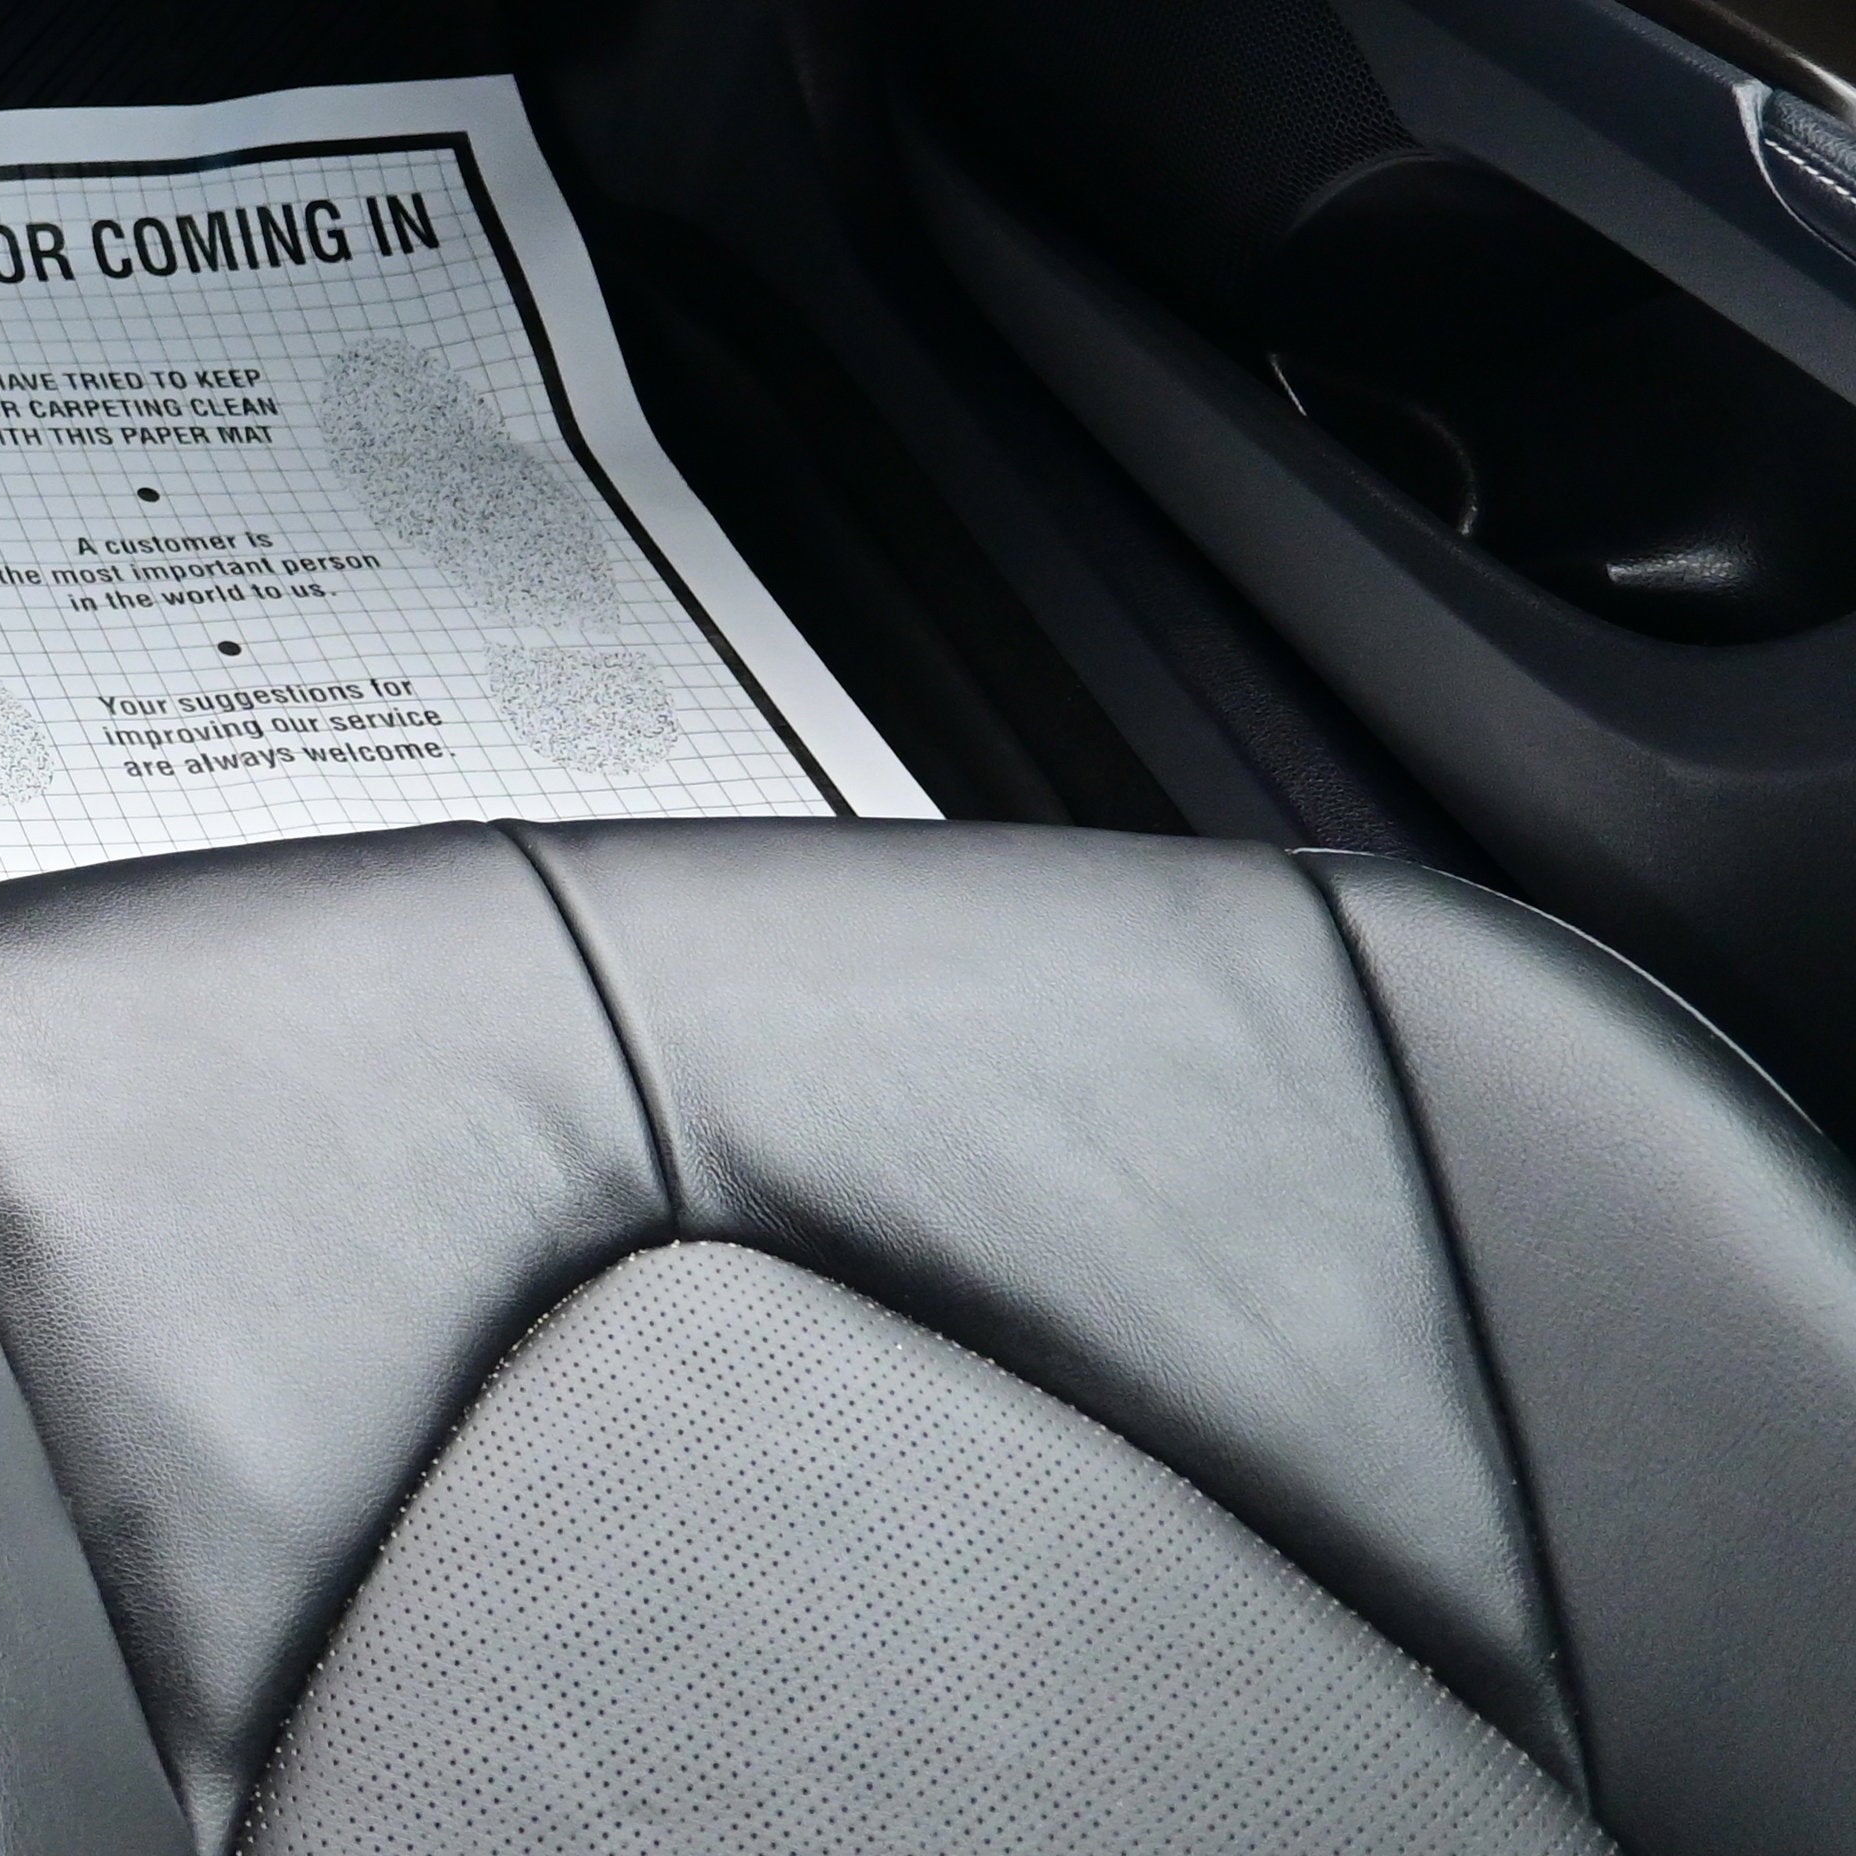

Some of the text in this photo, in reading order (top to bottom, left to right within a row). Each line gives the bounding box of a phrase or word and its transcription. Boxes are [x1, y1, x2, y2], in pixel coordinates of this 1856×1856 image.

[93, 198, 354, 281] COMING
[368, 192, 440, 257] IN
[62, 371, 143, 390] TRIED
[150, 371, 187, 389] TO
[195, 369, 262, 388] KEEP
[29, 399, 183, 418] CARPETING
[190, 397, 279, 417] CLEAN
[49, 427, 112, 445] THIS
[122, 426, 210, 445] PAPER
[218, 425, 273, 444] MAT
[77, 531, 273, 555] A customer is
[51, 563, 124, 585] most
[130, 555, 274, 588] important
[281, 551, 381, 577] person
[69, 581, 337, 612] in the world to us.
[98, 677, 413, 717] Your suggestions for
[102, 706, 443, 749] improving our service
[124, 741, 456, 778] are always welcome.
